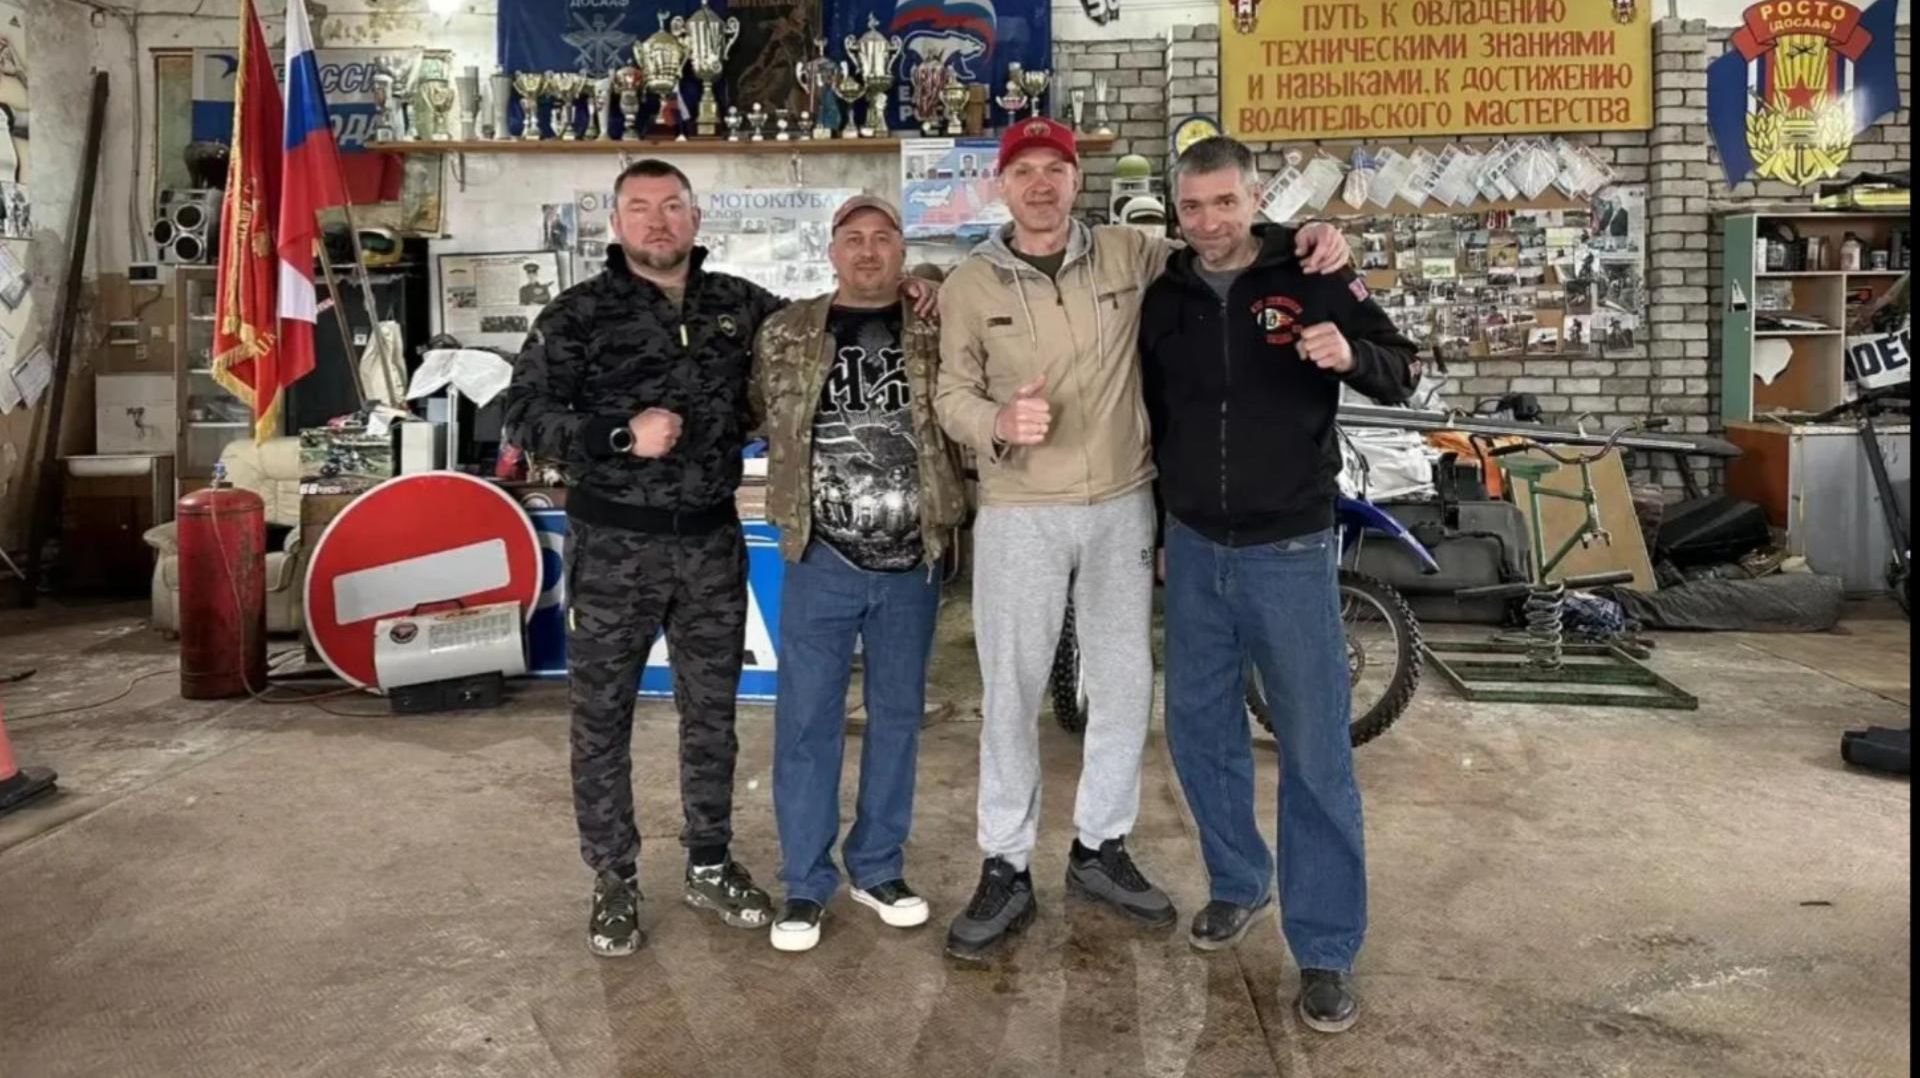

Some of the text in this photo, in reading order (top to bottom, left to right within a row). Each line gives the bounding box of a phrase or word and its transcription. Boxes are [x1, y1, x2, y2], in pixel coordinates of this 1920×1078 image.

[1303, 0, 1566, 31] ПУТЬ К ОВЛАДЕНИЮ
[1760, 0, 1846, 20] РОСТО
[1769, 18, 1837, 33] (ДОСААФ)
[1260, 31, 1615, 67] ТЕХНИЧЕСКИМИ ЗНАНИЯМИ
[1248, 74, 1264, 100] И
[1434, 68, 1450, 94] К
[1461, 63, 1633, 92] ДОСТИЖЕНИЮ
[1238, 97, 1631, 133] ВОДИТЕЛЬСКОГО МАСТЕРСТВА
